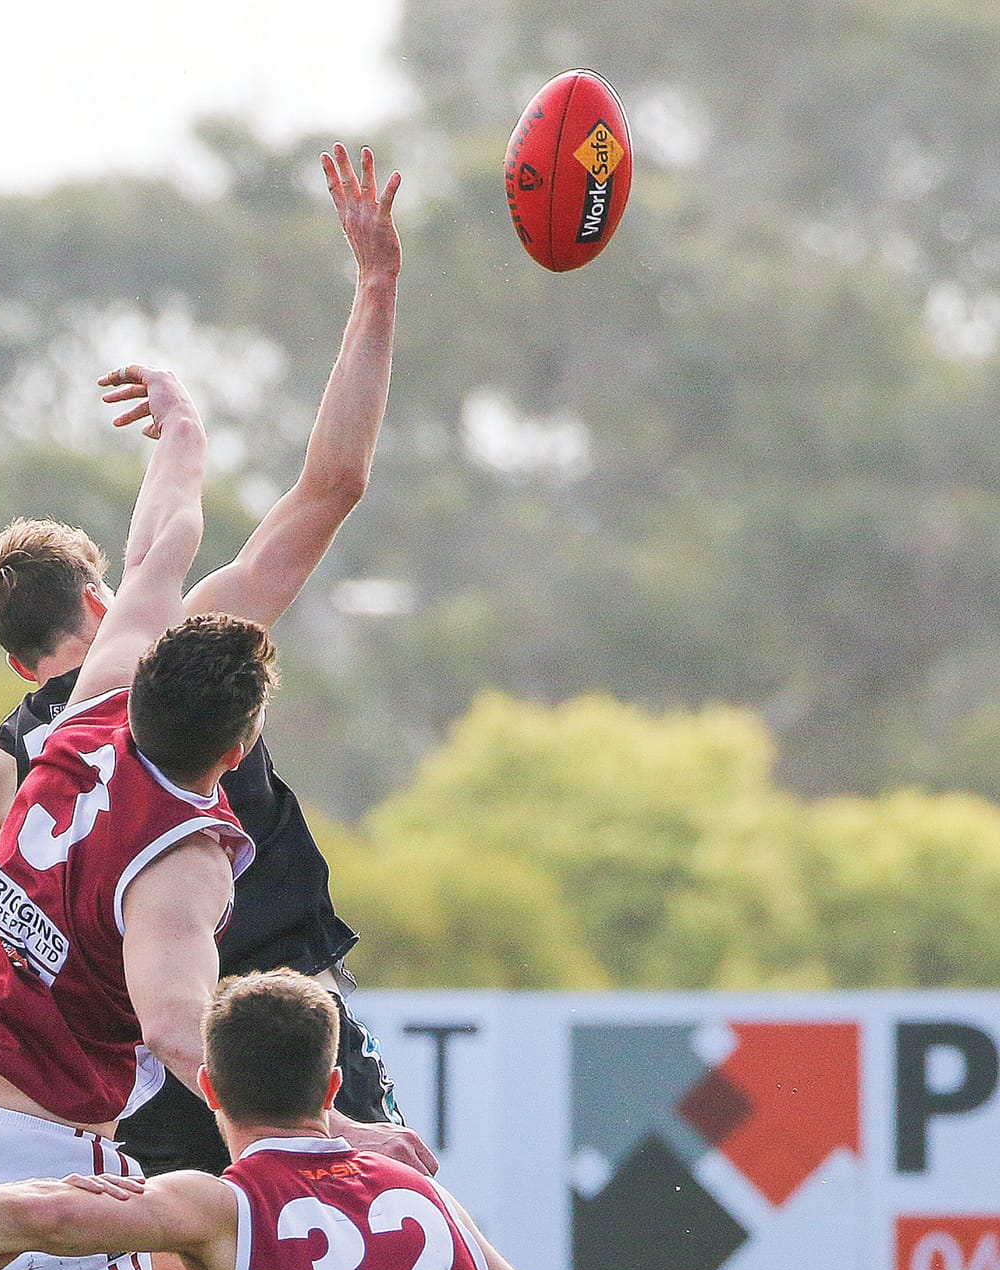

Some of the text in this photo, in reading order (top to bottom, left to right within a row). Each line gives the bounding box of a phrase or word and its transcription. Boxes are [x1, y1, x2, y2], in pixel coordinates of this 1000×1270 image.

[17, 744, 117, 871] 3
[9, 919, 36, 940] PTY
[35, 938, 59, 963] LTD
